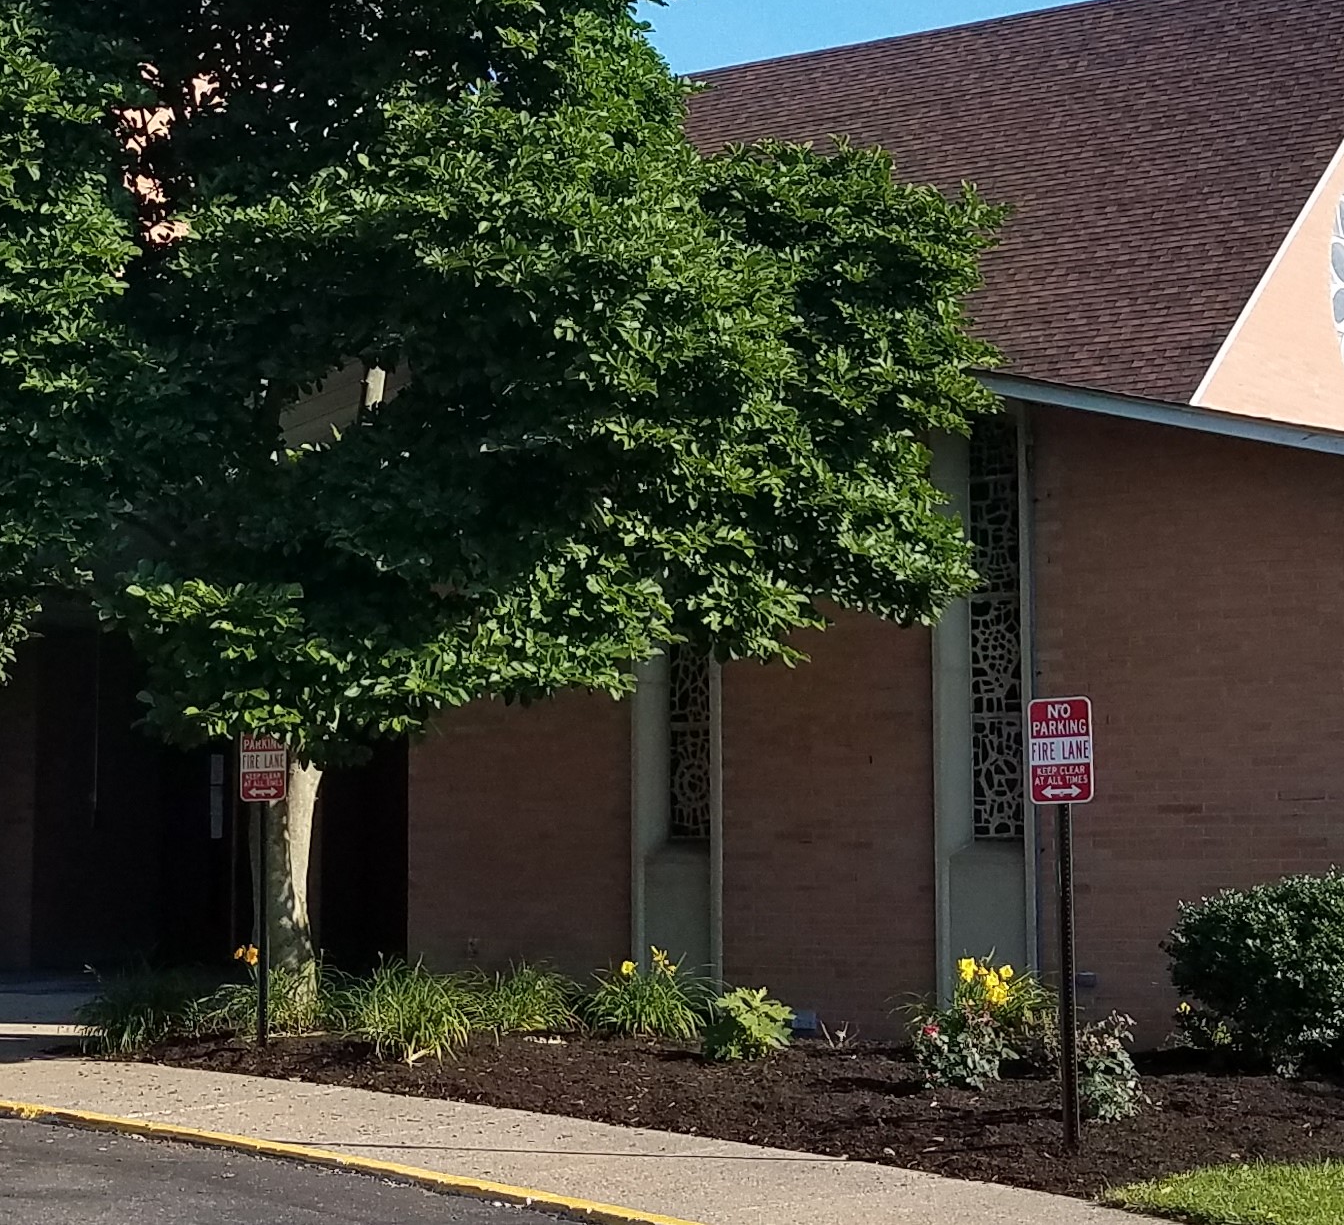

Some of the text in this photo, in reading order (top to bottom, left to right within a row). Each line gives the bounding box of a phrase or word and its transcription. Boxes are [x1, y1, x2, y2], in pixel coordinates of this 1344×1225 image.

[1047, 703, 1071, 719] NO
[1032, 719, 1087, 736] PARKING
[1031, 739, 1089, 761] FIRE LANE
[242, 754, 284, 769] FIRE LANE
[1036, 765, 1085, 776] KEEP CLEAR
[1034, 774, 1088, 786] AT ALL TIMES
